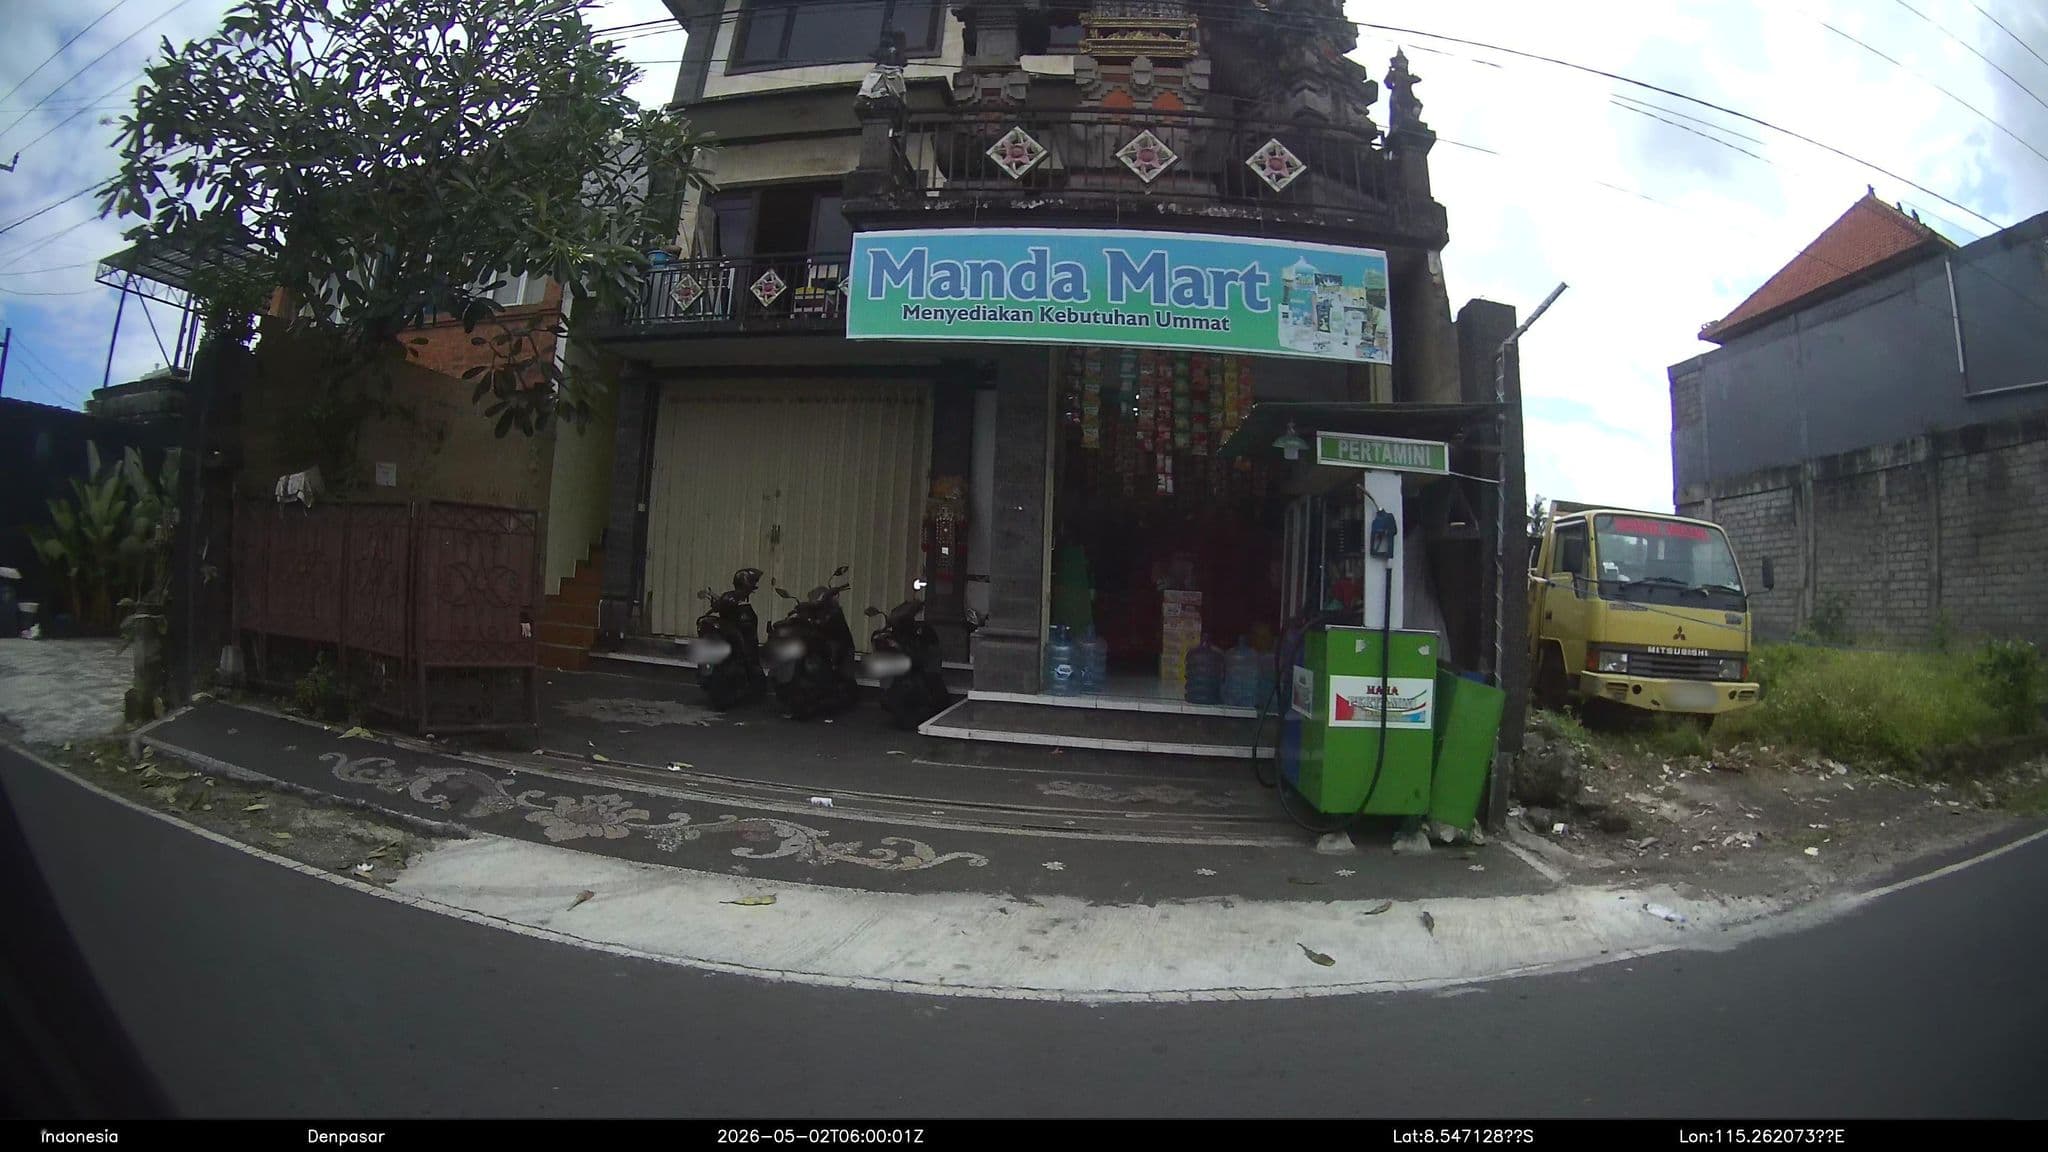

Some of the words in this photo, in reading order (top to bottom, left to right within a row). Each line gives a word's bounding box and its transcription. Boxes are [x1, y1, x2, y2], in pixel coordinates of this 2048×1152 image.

[867, 247, 1091, 303] Manda
[1103, 248, 1271, 313] Mart
[902, 304, 1035, 325] Menyediakan
[1039, 306, 1150, 327] Kebutuhan
[1155, 311, 1230, 331] Ummat
[1338, 439, 1431, 466] PERTAMINI
[1647, 645, 1709, 657] MITSUBISHI
